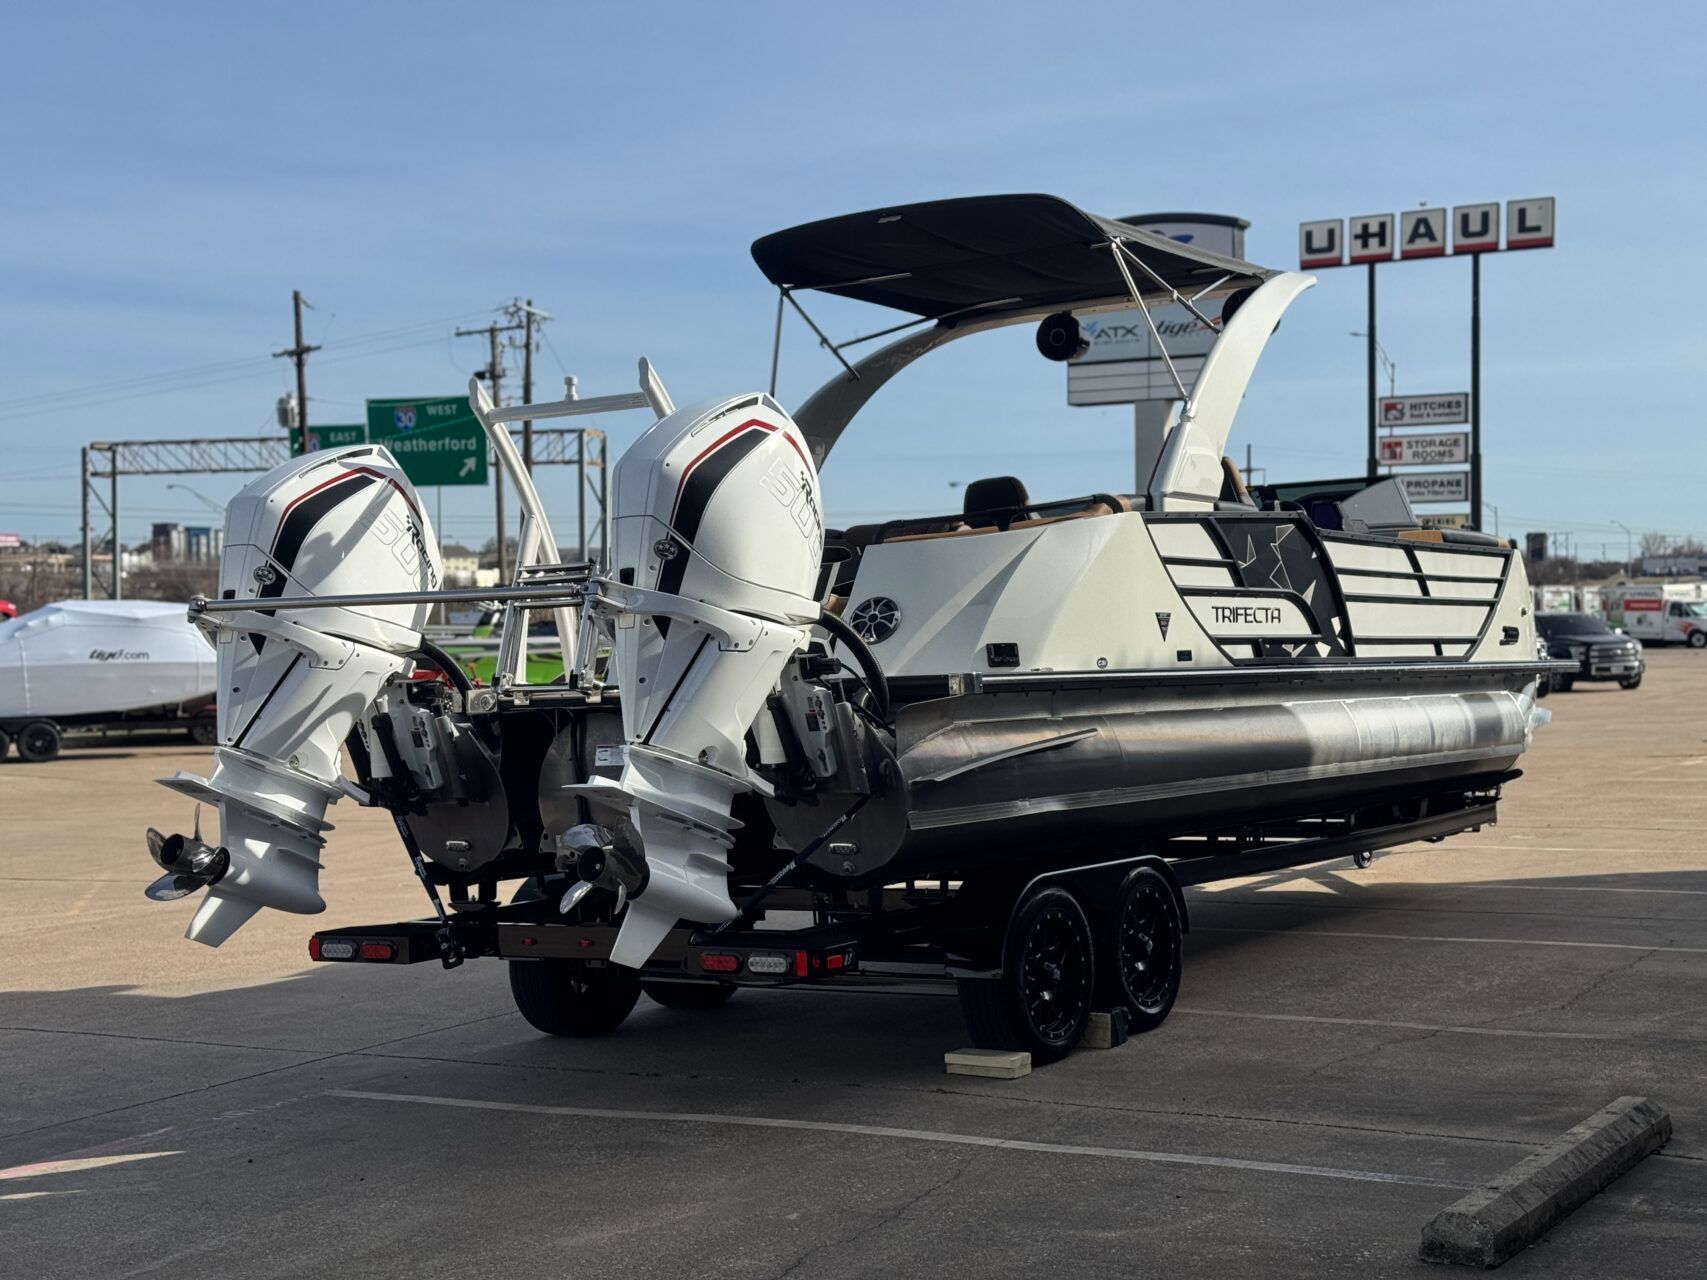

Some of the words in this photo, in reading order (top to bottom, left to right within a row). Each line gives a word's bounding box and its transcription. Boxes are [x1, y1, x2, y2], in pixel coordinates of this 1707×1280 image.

[1094, 323, 1139, 339] ATX
[426, 405, 457, 416] WEST
[1409, 400, 1462, 411] HITCHES
[400, 412, 415, 426] 30
[329, 432, 357, 443] EAST
[378, 437, 476, 451] Weatherford
[1406, 438, 1461, 449] STORAGE
[1412, 449, 1454, 460] ROOMS
[1406, 479, 1462, 489] PROPANE
[1211, 605, 1281, 624] TRIFECTA
